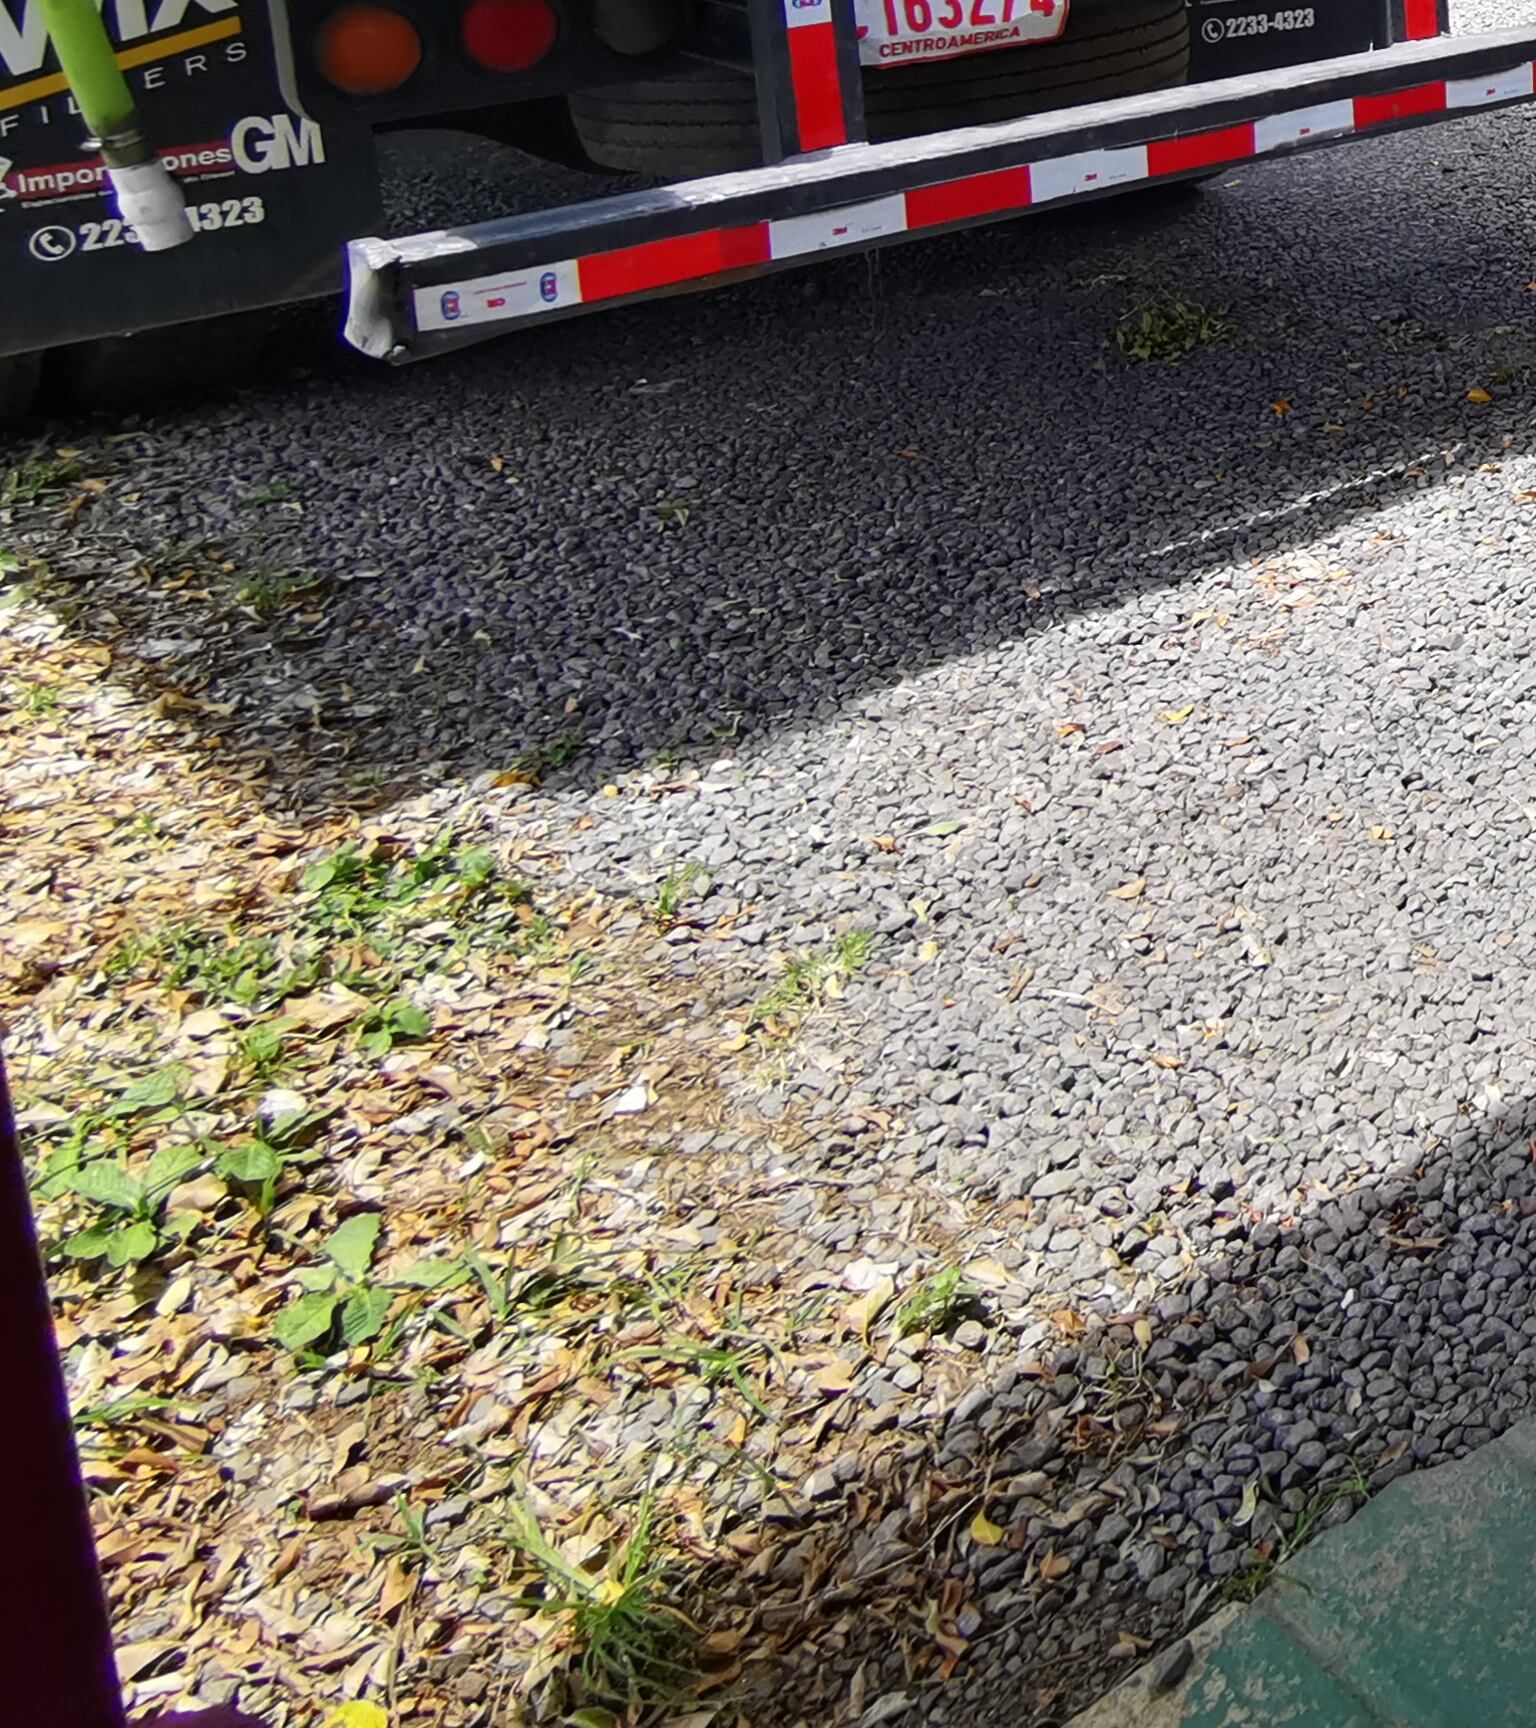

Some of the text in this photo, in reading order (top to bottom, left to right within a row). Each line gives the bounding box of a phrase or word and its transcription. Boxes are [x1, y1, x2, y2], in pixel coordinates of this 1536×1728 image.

[879, 26, 1021, 58] CENTROAMERICA
[1225, 7, 1316, 39] 2233-4323
[0, 41, 248, 138] FILERS
[17, 113, 326, 194] Imporones GM
